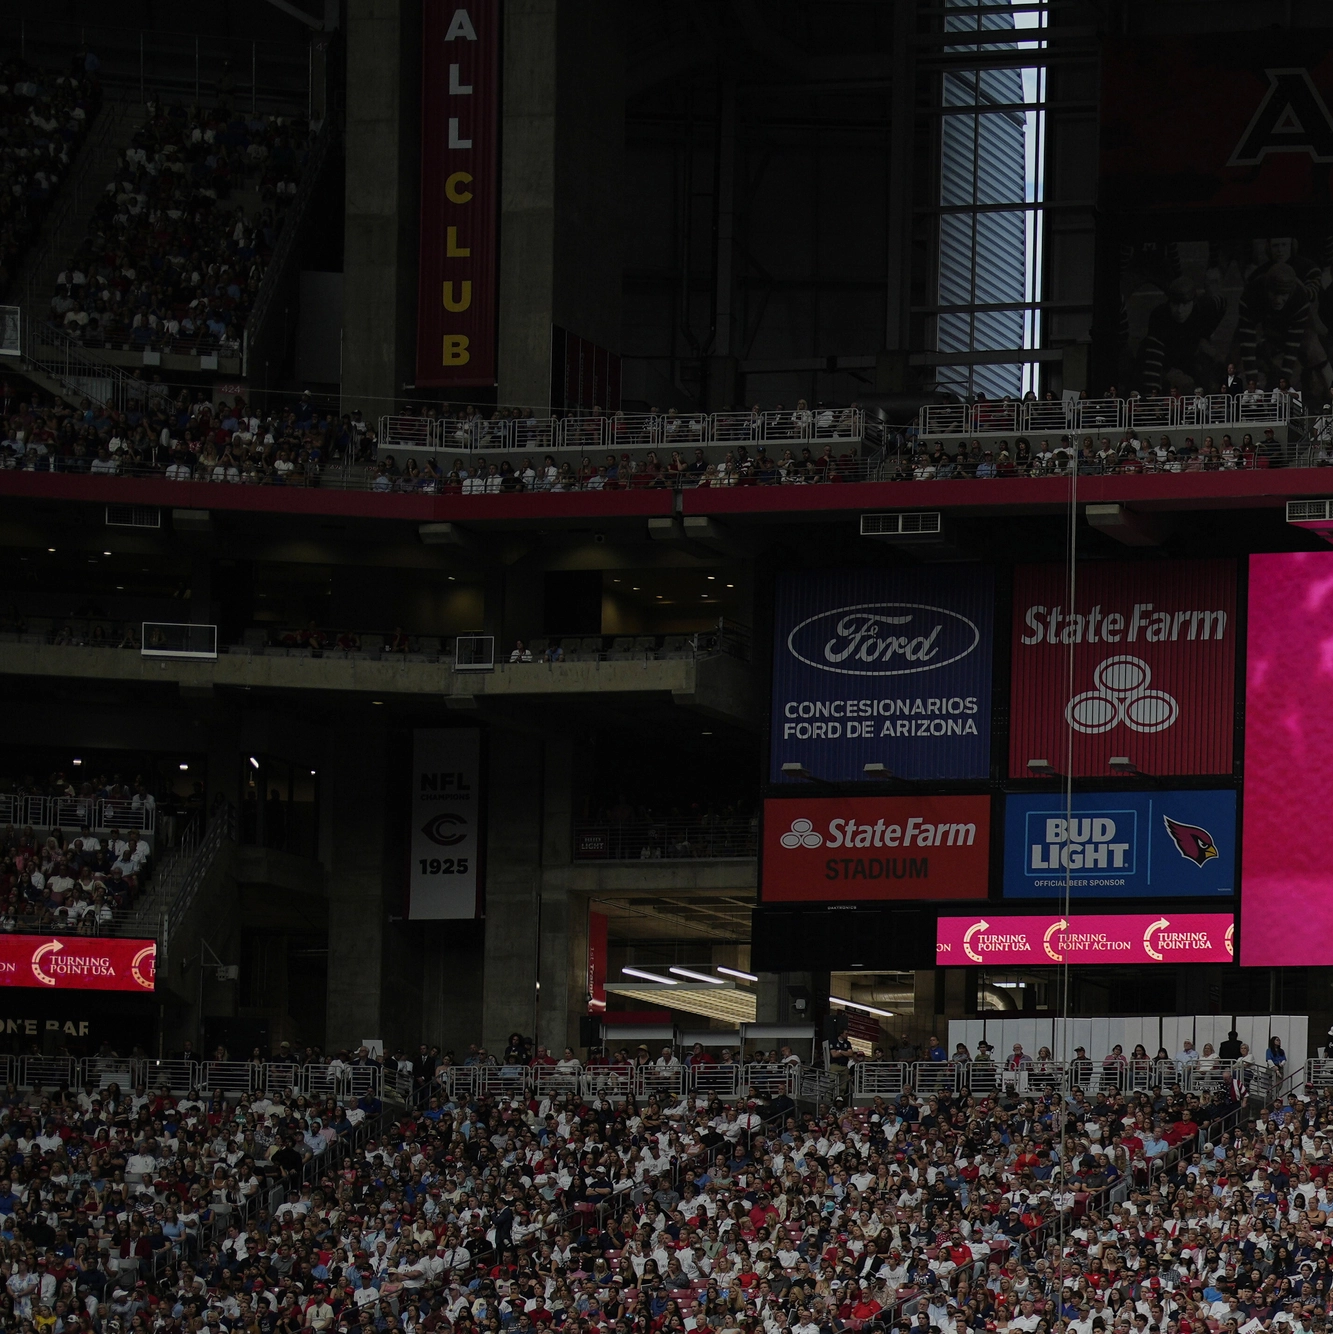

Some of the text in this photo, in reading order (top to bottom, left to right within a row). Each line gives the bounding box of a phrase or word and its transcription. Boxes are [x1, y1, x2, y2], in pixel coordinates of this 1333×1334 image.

[442, 171, 475, 367] CLUB
[221, 384, 241, 394] 424
[824, 612, 942, 663] Ford
[784, 697, 978, 719] CONCESIONARIOS
[783, 716, 978, 740] FORD DE ARIZONA
[420, 772, 471, 792] NFL
[420, 793, 471, 801] CHAMPIONS
[1045, 817, 1117, 844] BUD
[581, 842, 605, 851] LIGHT
[1030, 842, 1128, 870] LIGHT
[419, 858, 469, 875] 1925
[825, 858, 928, 881] STADIUM
[1034, 878, 1125, 888] OFFICIAL BEER SPONSOR
[978, 934, 1027, 944] TURNING
[1058, 933, 1107, 943] TURNING
[1158, 932, 1207, 942] TURNING
[978, 941, 1031, 952] POINT USA
[1058, 941, 1131, 950] POINT ACTION
[1158, 940, 1212, 950] POINT USA
[49, 956, 111, 968] TURNING
[50, 965, 116, 976] POINT USA
